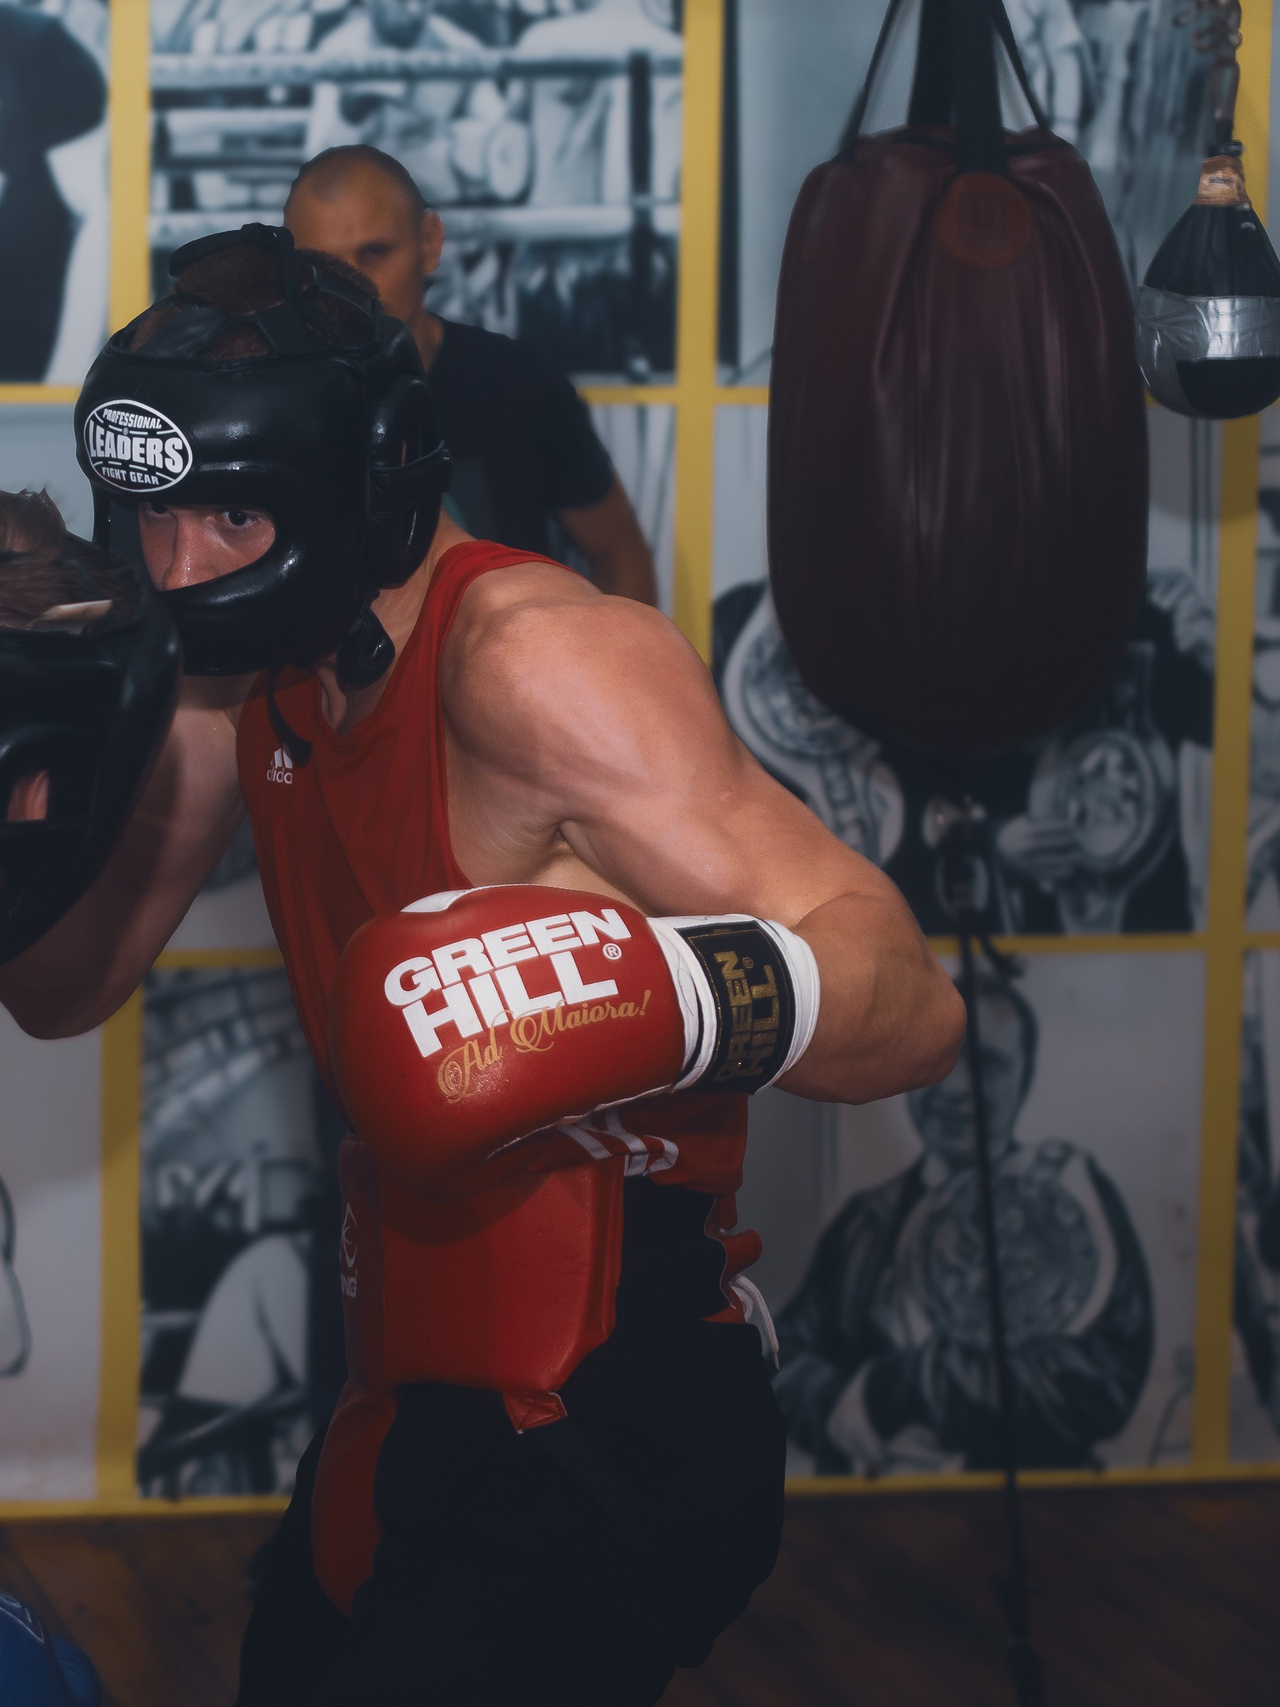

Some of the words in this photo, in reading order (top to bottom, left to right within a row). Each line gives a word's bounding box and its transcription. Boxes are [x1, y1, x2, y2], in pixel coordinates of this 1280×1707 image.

[89, 419, 184, 473] LEADERS
[103, 409, 162, 429] PROFESSIONAL
[102, 467, 127, 481] FIGHT
[130, 472, 160, 485] GEAR
[384, 908, 632, 1006] GREEN
[402, 951, 619, 1058] HILL
[437, 1009, 514, 1104] Ad
[510, 989, 652, 1053] Maiora!
[734, 964, 780, 1076] HILL
